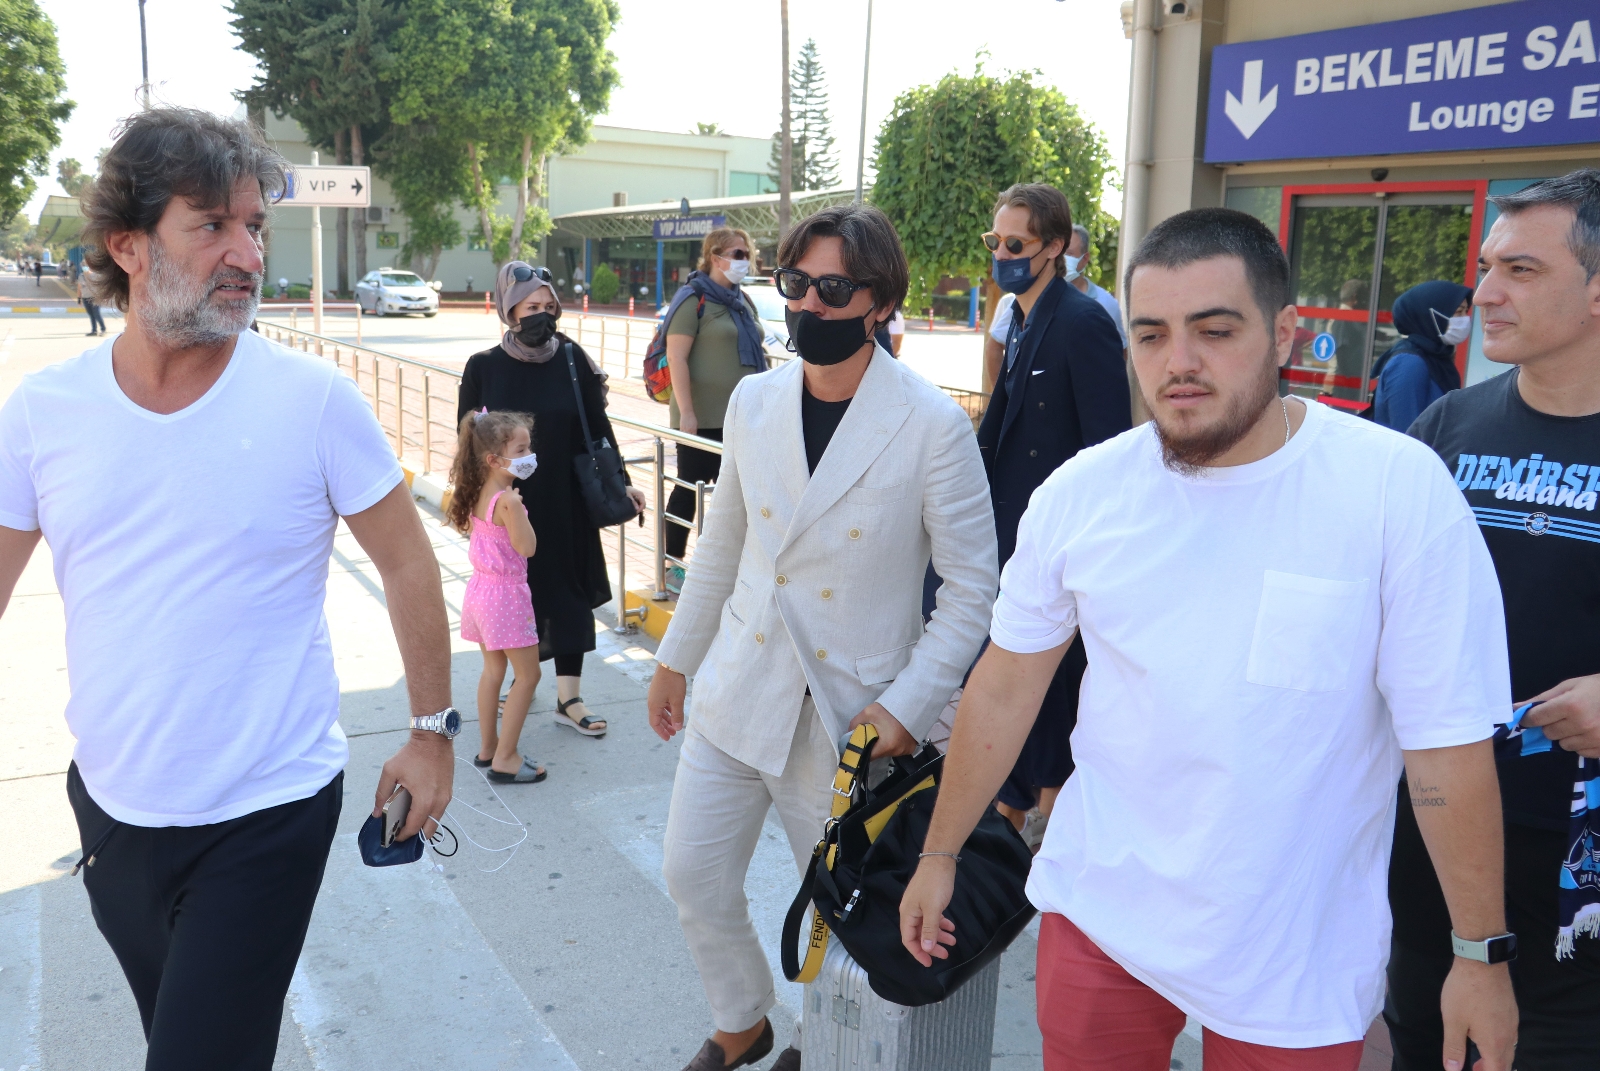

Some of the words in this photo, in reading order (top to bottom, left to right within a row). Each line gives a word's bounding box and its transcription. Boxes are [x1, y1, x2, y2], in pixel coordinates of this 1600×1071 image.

[1294, 32, 1508, 96] BEKLEME
[1522, 19, 1600, 71] SA
[1408, 97, 1555, 133] Lounge
[1568, 83, 1600, 120] E
[309, 180, 336, 191] VIP
[659, 222, 674, 235] VIP
[675, 219, 713, 235] LOUNGE
[1495, 474, 1598, 511] adana
